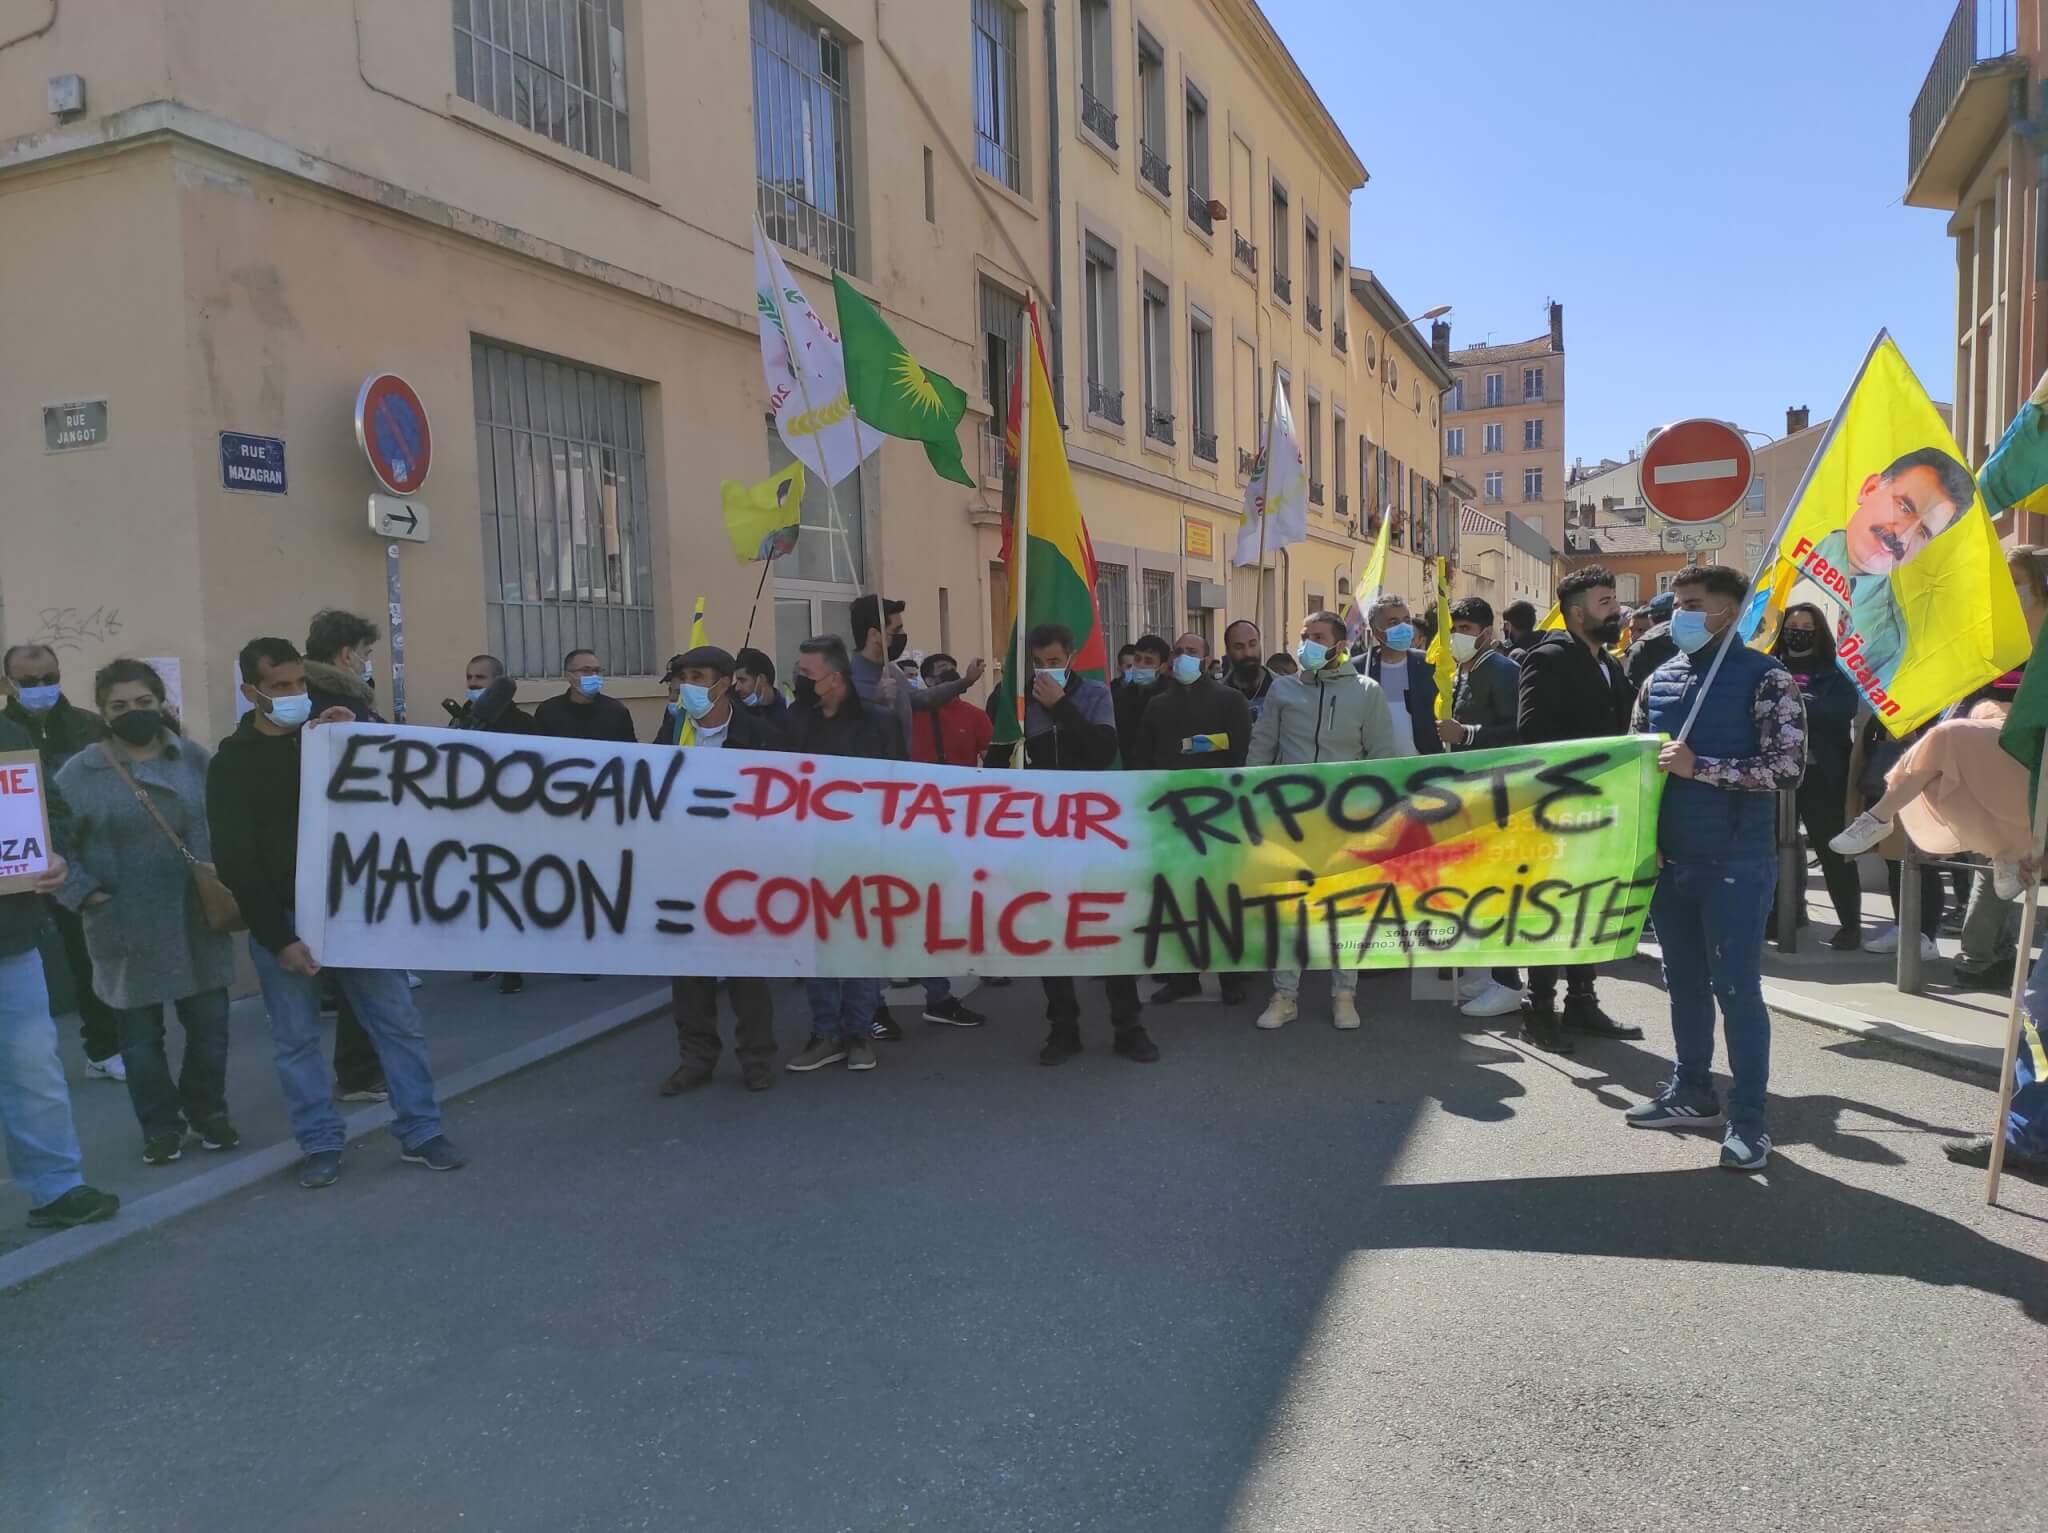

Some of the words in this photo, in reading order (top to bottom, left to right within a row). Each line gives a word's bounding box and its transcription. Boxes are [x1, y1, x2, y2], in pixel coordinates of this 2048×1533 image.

[66, 414, 86, 427] RUE
[57, 428, 97, 445] JANGOT
[241, 444, 267, 460] RUE
[228, 465, 283, 485] MAZAGRAN
[325, 733, 685, 826] ERDOGAN
[326, 831, 634, 941] MACRON
